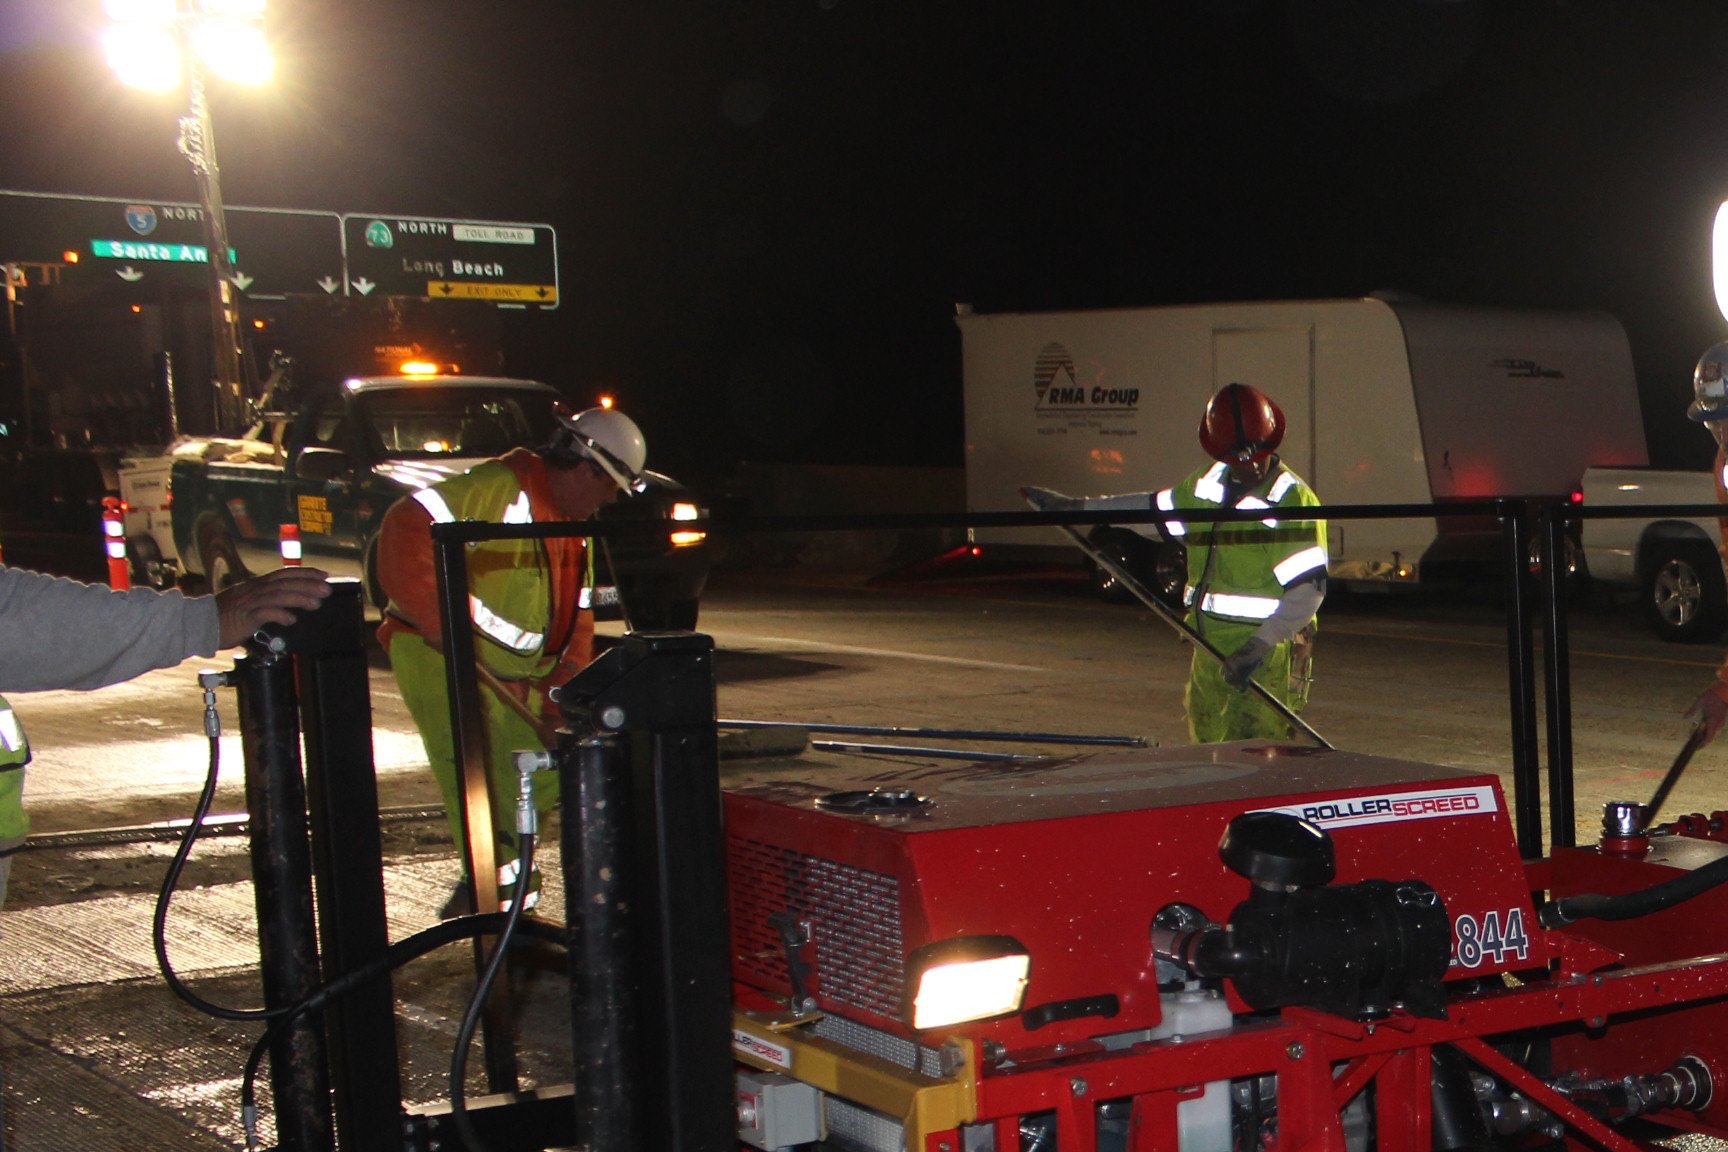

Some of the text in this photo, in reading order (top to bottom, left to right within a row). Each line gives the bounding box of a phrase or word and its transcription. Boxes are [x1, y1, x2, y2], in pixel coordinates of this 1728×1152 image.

[136, 213, 148, 229] 5
[162, 206, 205, 221] NORT
[397, 221, 448, 235] NORTH
[464, 228, 525, 240] TOLL ROAD
[366, 229, 388, 243] 73
[110, 240, 209, 263] Santa An
[402, 257, 504, 278] Long Beach
[467, 286, 521, 297] EXIT ONLY
[1049, 386, 1140, 406] RMA Group
[1455, 907, 1528, 968] 844
